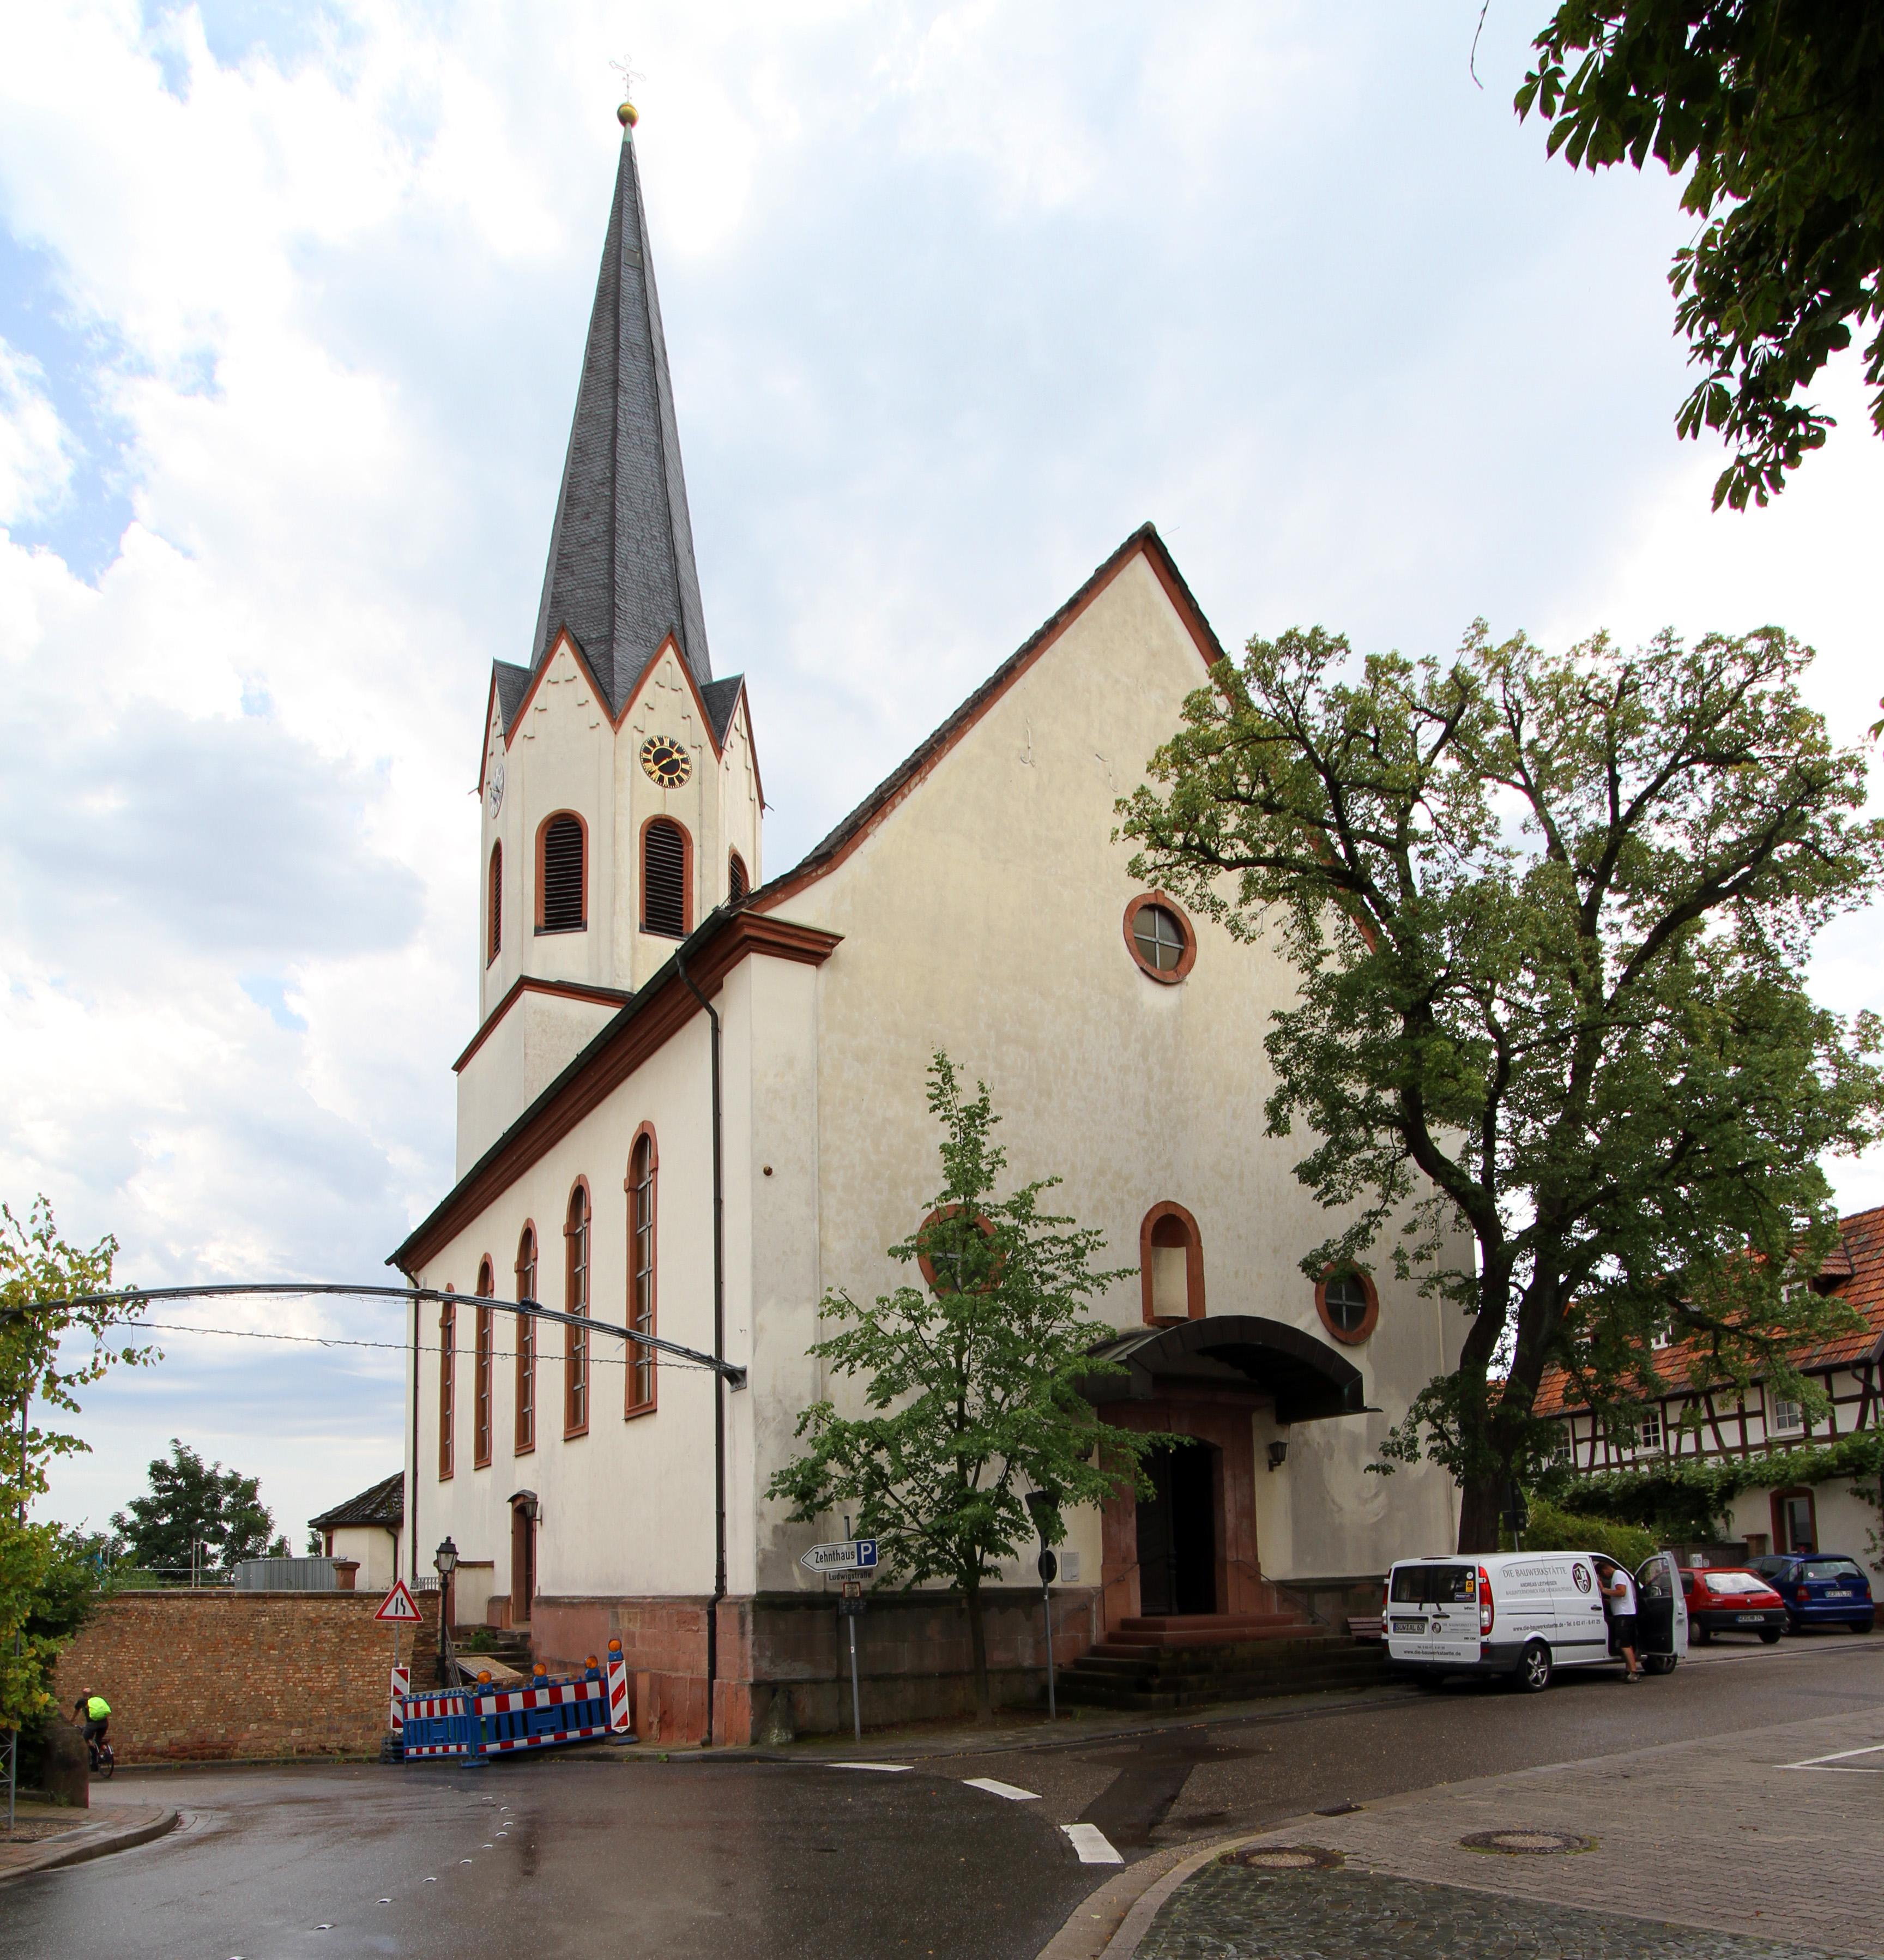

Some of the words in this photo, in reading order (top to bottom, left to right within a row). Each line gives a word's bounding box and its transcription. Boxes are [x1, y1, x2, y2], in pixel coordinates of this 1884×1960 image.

[814, 1549, 855, 1563] Zehnthaus
[861, 1543, 872, 1564] P
[829, 1571, 872, 1581] Ludwigstraße
[1502, 1570, 1514, 1578] DIE
